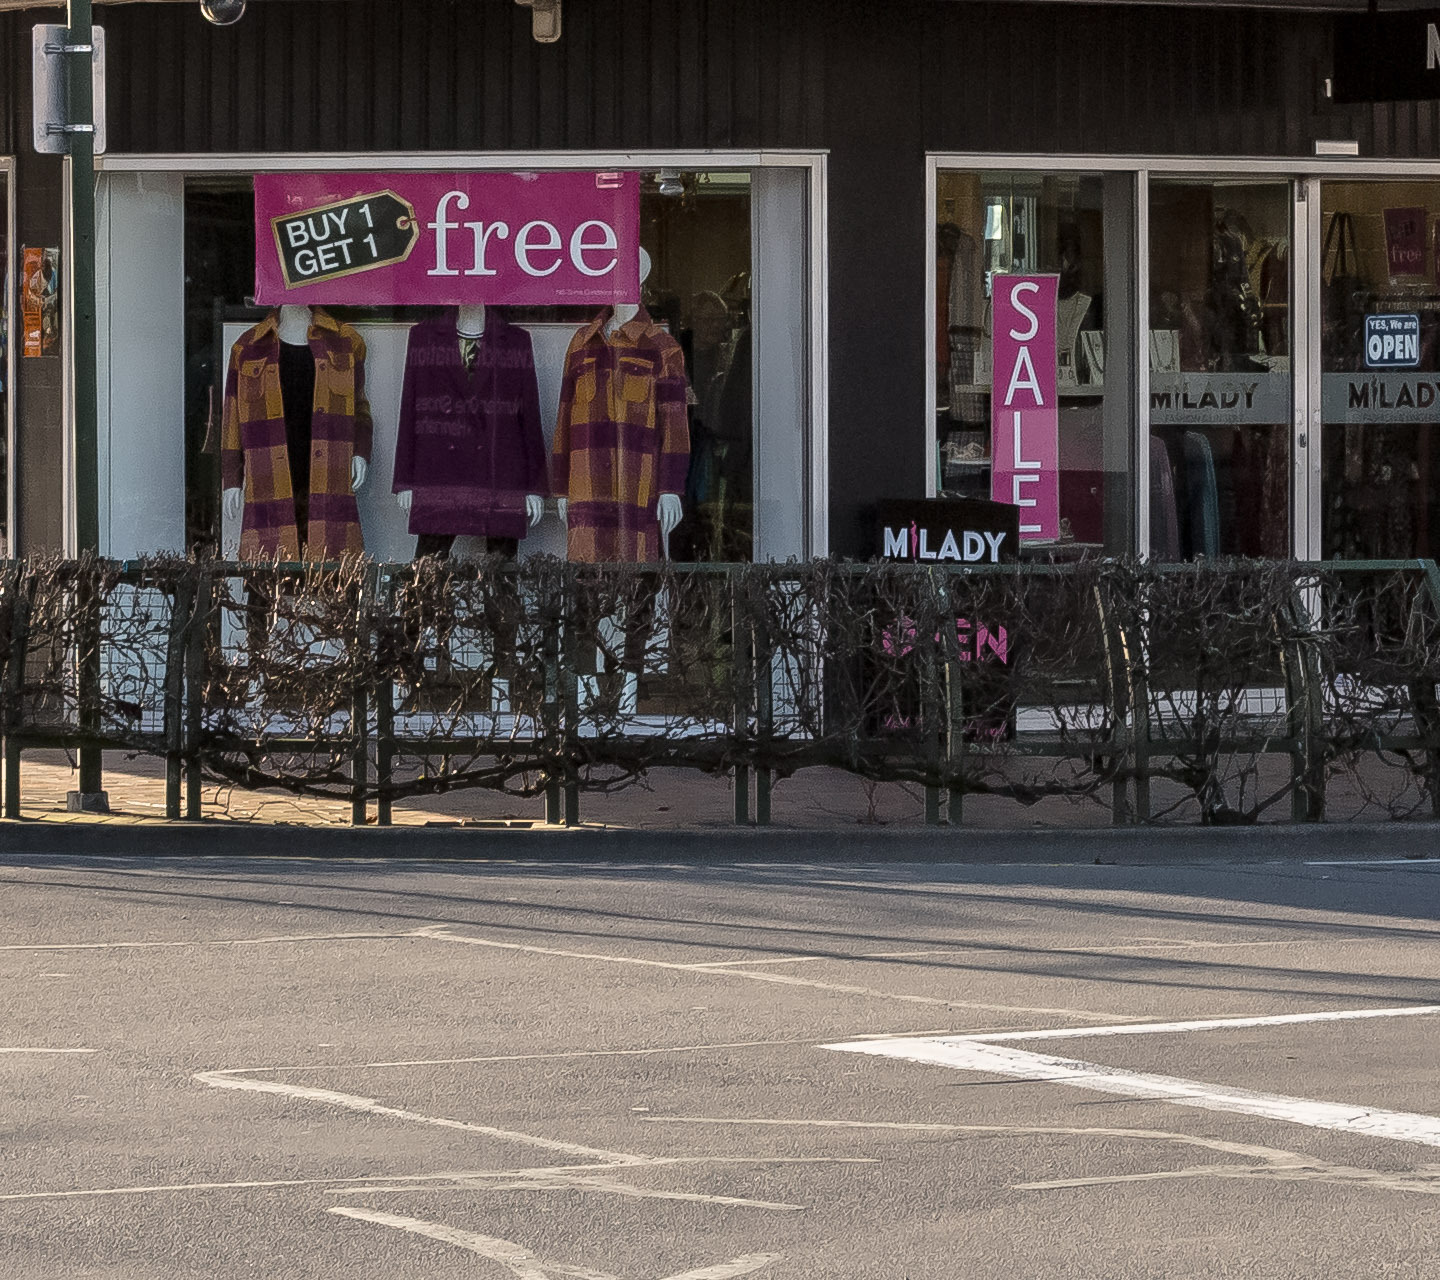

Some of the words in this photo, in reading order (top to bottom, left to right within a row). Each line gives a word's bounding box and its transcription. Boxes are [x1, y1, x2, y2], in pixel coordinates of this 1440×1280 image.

[286, 208, 349, 248] BUY
[358, 203, 374, 228] 1
[426, 190, 618, 277] free
[294, 238, 354, 276] GET
[363, 232, 378, 258] 1
[1368, 334, 1417, 361] OPEN
[1369, 319, 1389, 332] YES,
[1390, 320, 1403, 330] We
[1404, 321, 1417, 330] are
[1004, 281, 1045, 533] SALE
